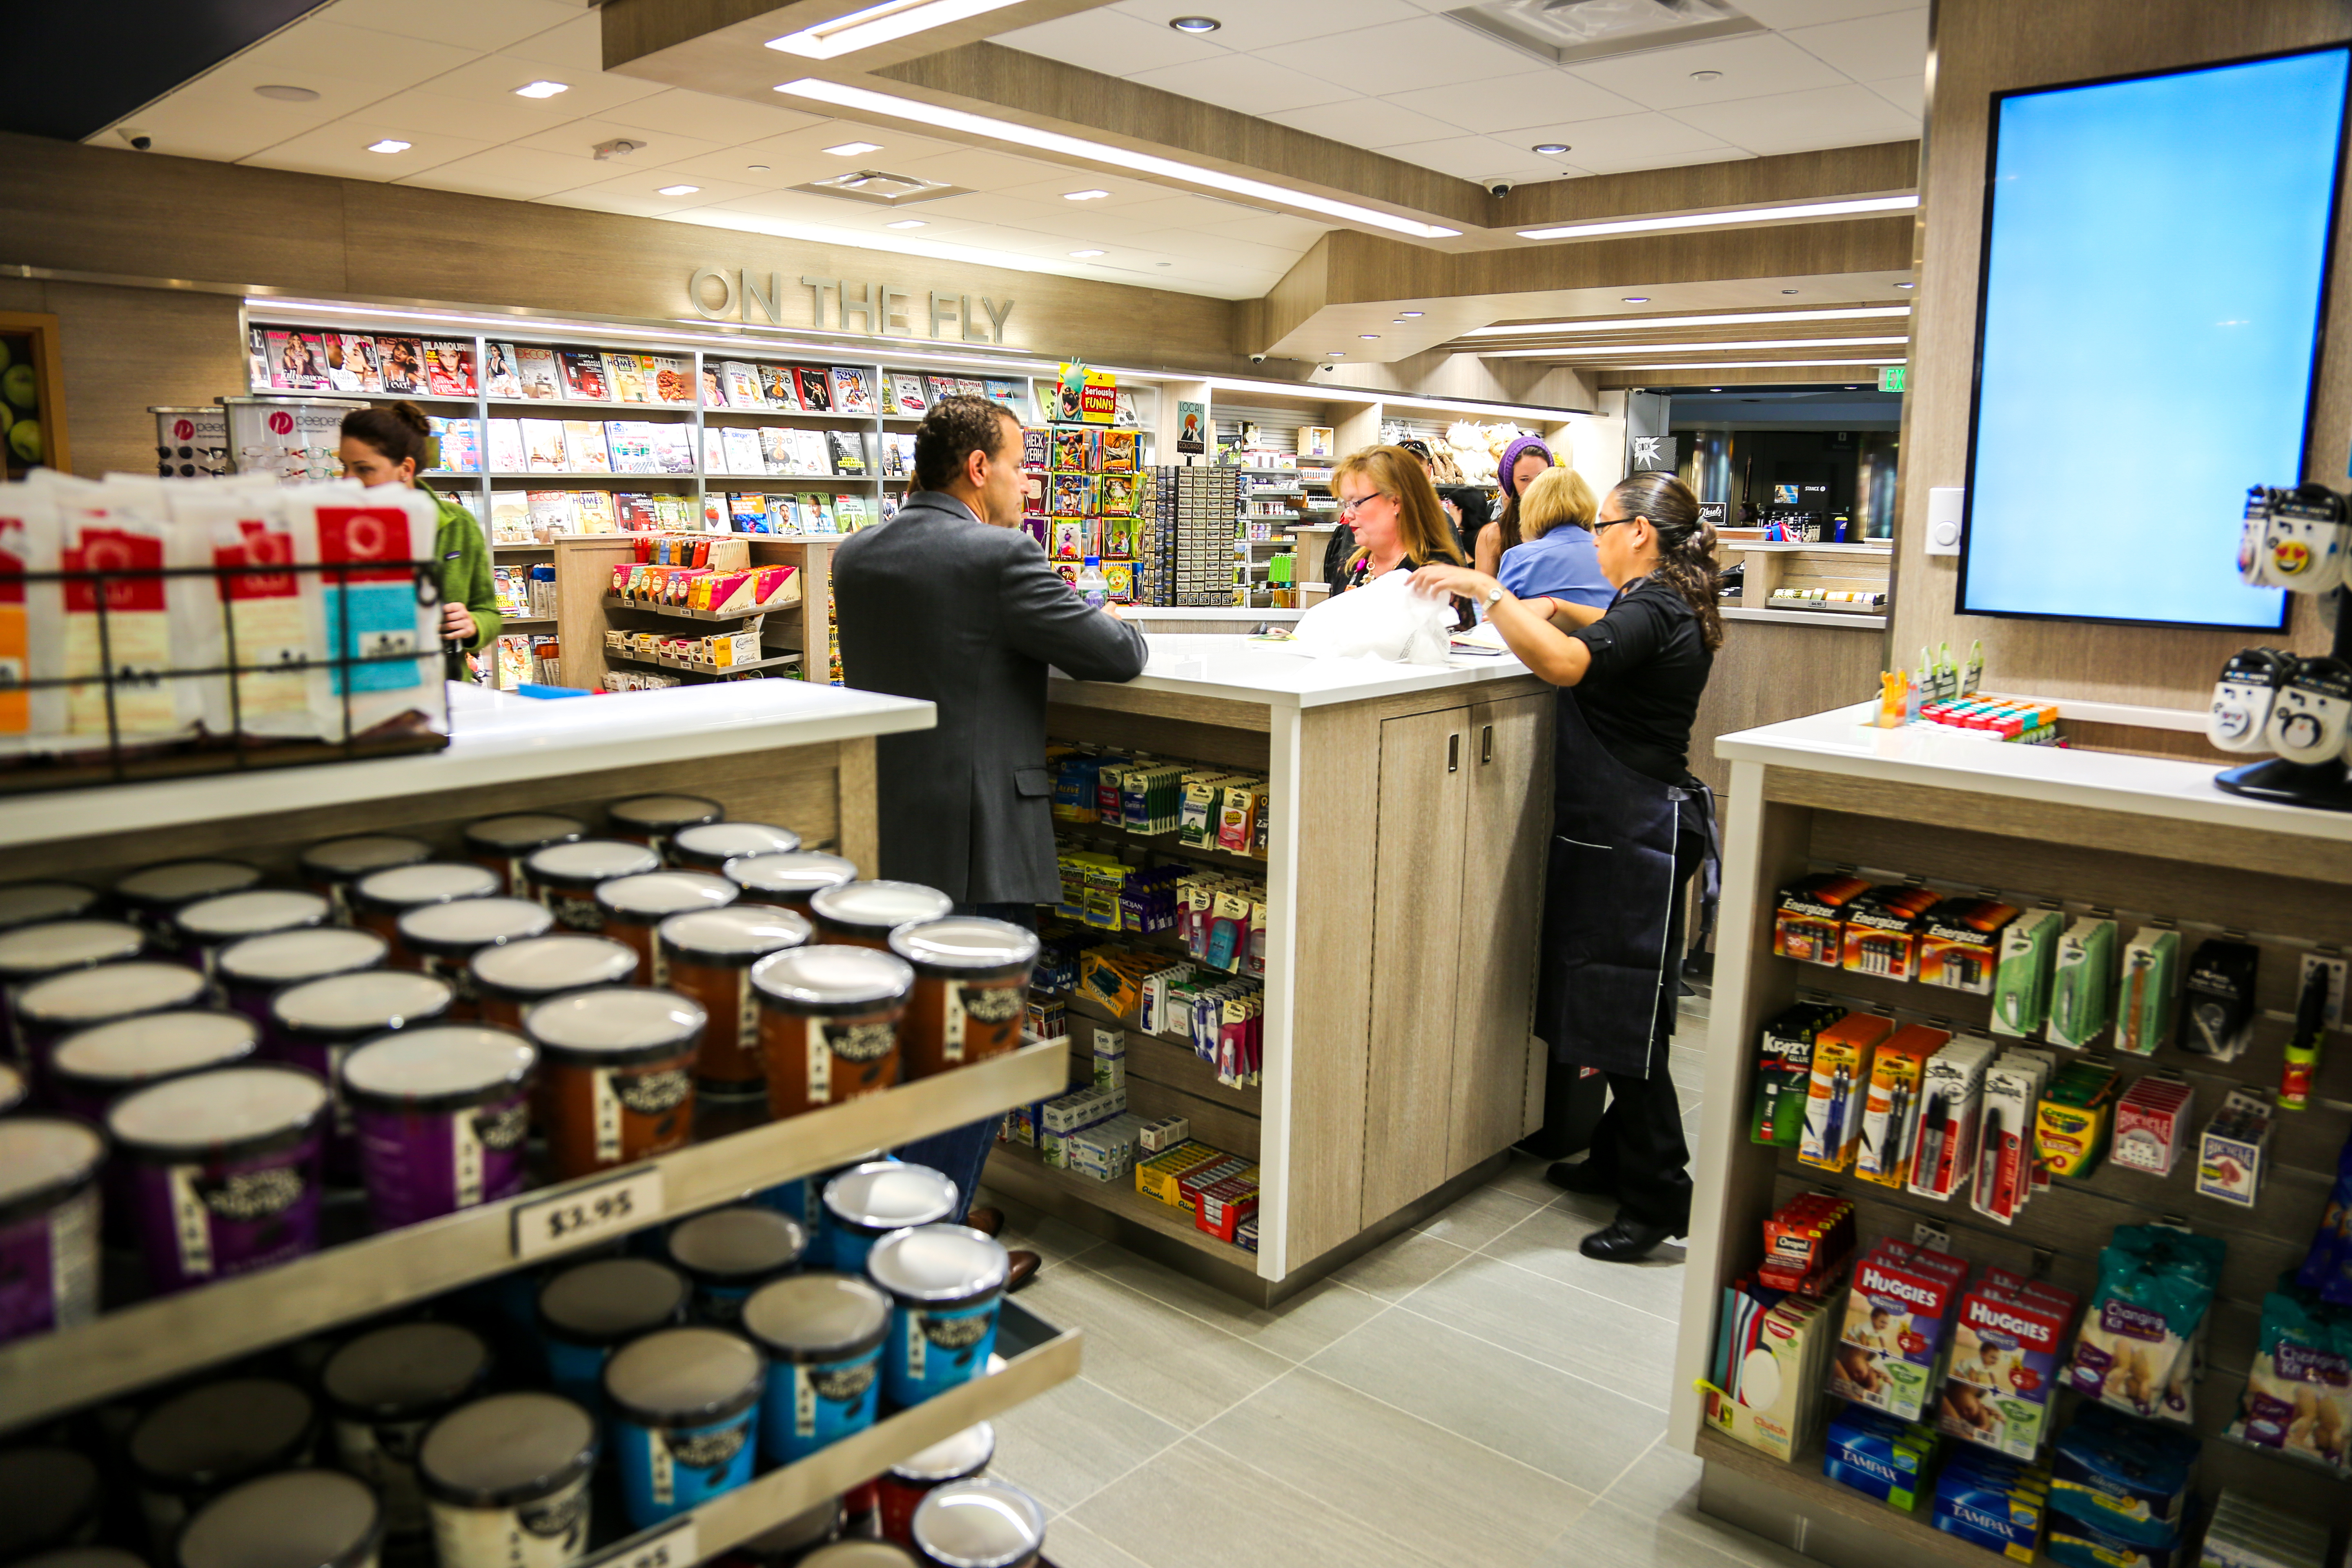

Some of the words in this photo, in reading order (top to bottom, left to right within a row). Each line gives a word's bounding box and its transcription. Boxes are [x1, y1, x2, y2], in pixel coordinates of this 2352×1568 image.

[691, 266, 781, 324] ON
[802, 275, 911, 335] THE
[931, 291, 1015, 343] FLY
[422, 341, 466, 351] GLAMOUR
[515, 348, 552, 360] DECOR
[766, 374, 791, 383] FOOD
[836, 370, 862, 381] 5280
[1886, 369, 1905, 390] EX
[1085, 387, 1114, 398] Seriously
[1085, 397, 1114, 410] FUNNY
[1180, 402, 1202, 413] LOCAL
[196, 422, 226, 433] peep
[296, 415, 342, 427] peepers
[1027, 434, 1043, 448] HECK
[1638, 442, 1651, 451] SOCK
[1026, 448, 1044, 462] YEAH!
[530, 490, 566, 501] DECOR
[724, 603, 748, 612] Chocolove
[1058, 785, 1080, 794] ALEVE
[1086, 874, 1120, 888] Dramamine
[1119, 898, 1143, 910] TROJAN
[1225, 902, 1239, 912] Degree
[1782, 898, 1836, 918] Energizer
[1851, 911, 1908, 931] Energizer
[1928, 924, 1987, 944] Energizer
[1086, 980, 1120, 1011] NEOSPORIN
[1788, 1054, 1810, 1063] GLUE
[2045, 1107, 2085, 1123] Crayola
[2120, 1115, 2170, 1132] BICYCLE
[2207, 1141, 2253, 1166] BICYCLE
[1142, 1186, 1164, 1200] Ricola
[1862, 1267, 1936, 1307] HUGGIES
[1969, 1301, 2050, 1342] HUGGIES
[2106, 1303, 2165, 1330] Changing
[2106, 1316, 2123, 1330] Kit
[2280, 1347, 2349, 1372] Changing
[2281, 1362, 2301, 1375] Kit
[1754, 1416, 1786, 1436] Clutch
[1759, 1426, 1788, 1445] Clean
[1842, 1449, 1898, 1482] TAMPAX
[1952, 1504, 2014, 1538] TAMPAX
